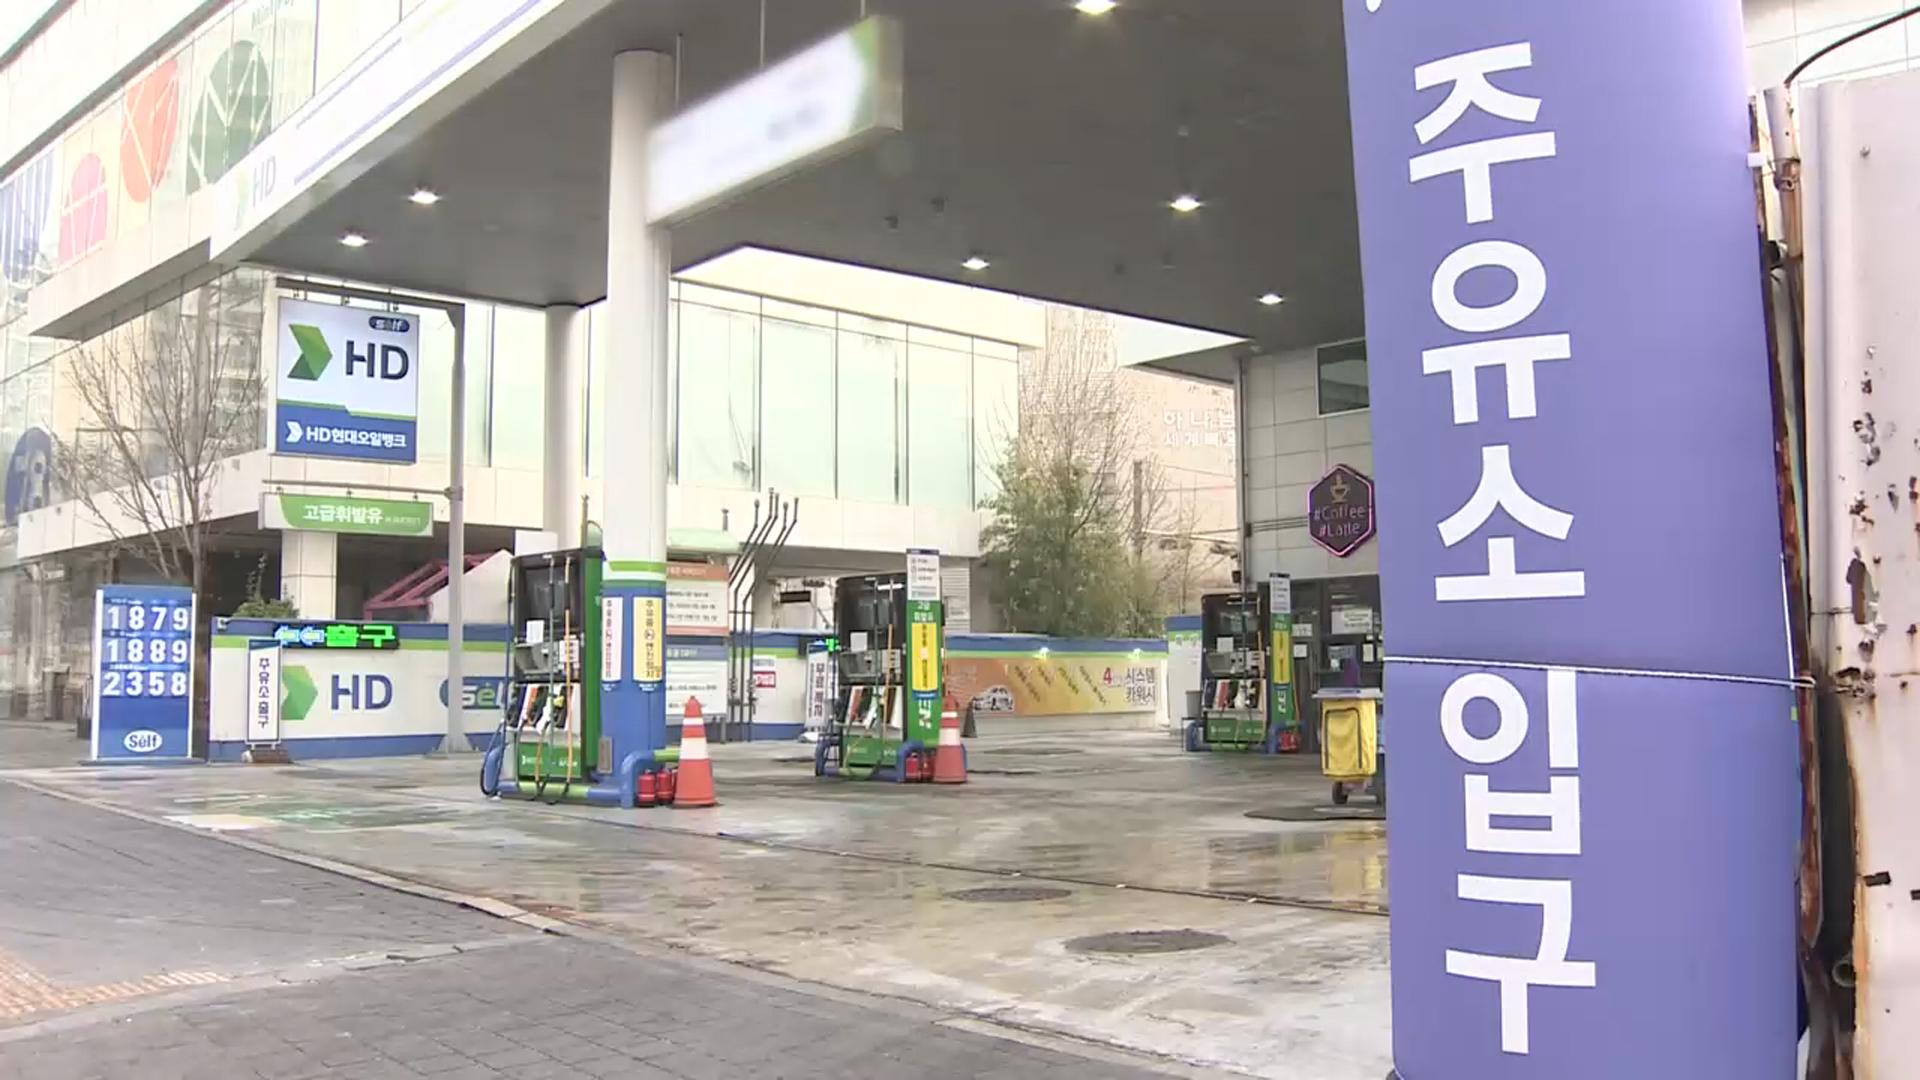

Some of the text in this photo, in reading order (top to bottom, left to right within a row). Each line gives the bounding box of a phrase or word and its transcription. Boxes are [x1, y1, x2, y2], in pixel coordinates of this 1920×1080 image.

[252, 156, 277, 208] HD
[345, 340, 410, 380] HD
[306, 425, 407, 448] HD현대오일뱅크
[303, 504, 384, 525] 고급휘발유
[1314, 505, 1366, 521] #Coffee
[1319, 523, 1360, 537] #Latte
[1409, 40, 1598, 1055] 주유소 입구
[107, 606, 188, 631] 1879
[106, 638, 188, 663] 1889
[102, 671, 187, 697] 2358
[1103, 667, 1156, 684] 4 시스템
[331, 674, 393, 710] HD
